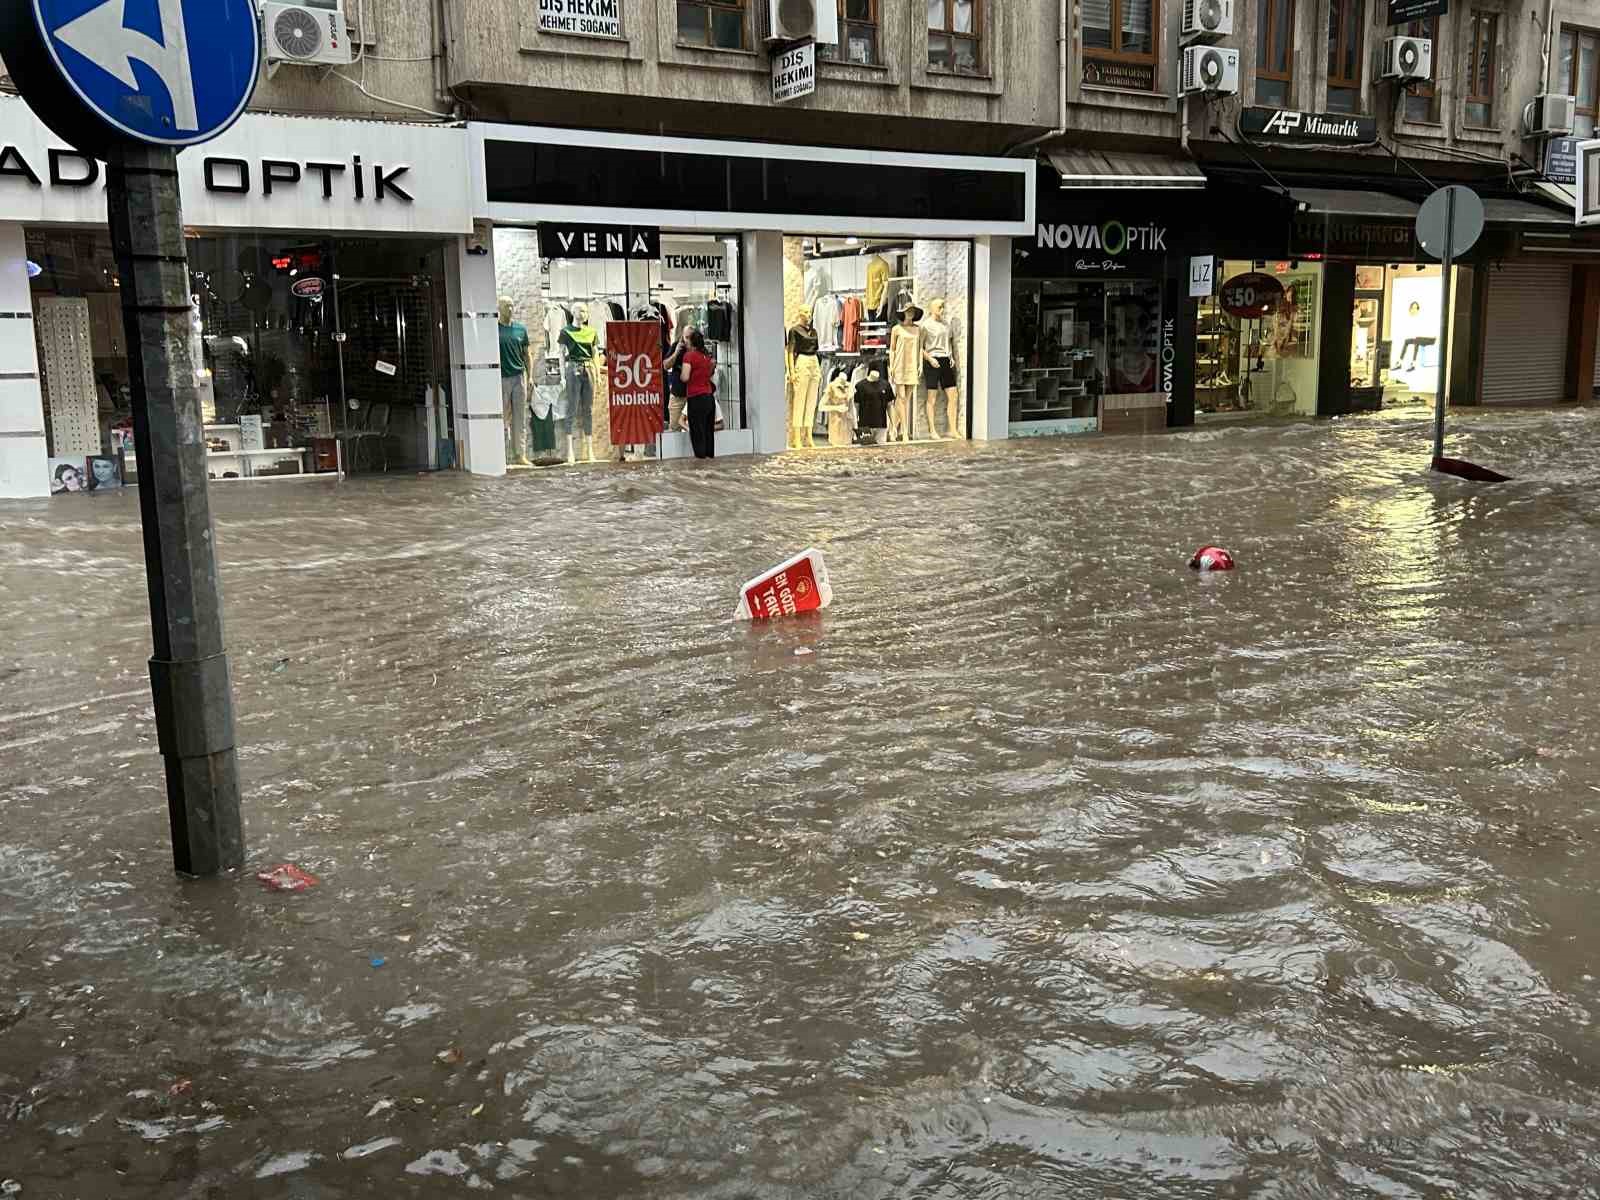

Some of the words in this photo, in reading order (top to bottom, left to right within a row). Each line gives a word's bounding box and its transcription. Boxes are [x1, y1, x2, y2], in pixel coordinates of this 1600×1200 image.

[540, 15, 577, 31] MEHMET
[782, 51, 803, 69] DİŞ
[1304, 116, 1359, 137] Mimarlık
[0, 145, 108, 187] AD
[204, 154, 413, 201] OPTİK
[556, 231, 649, 253] VENA
[664, 254, 723, 270] TEKUMUT
[611, 390, 661, 406] İNDİRİM
